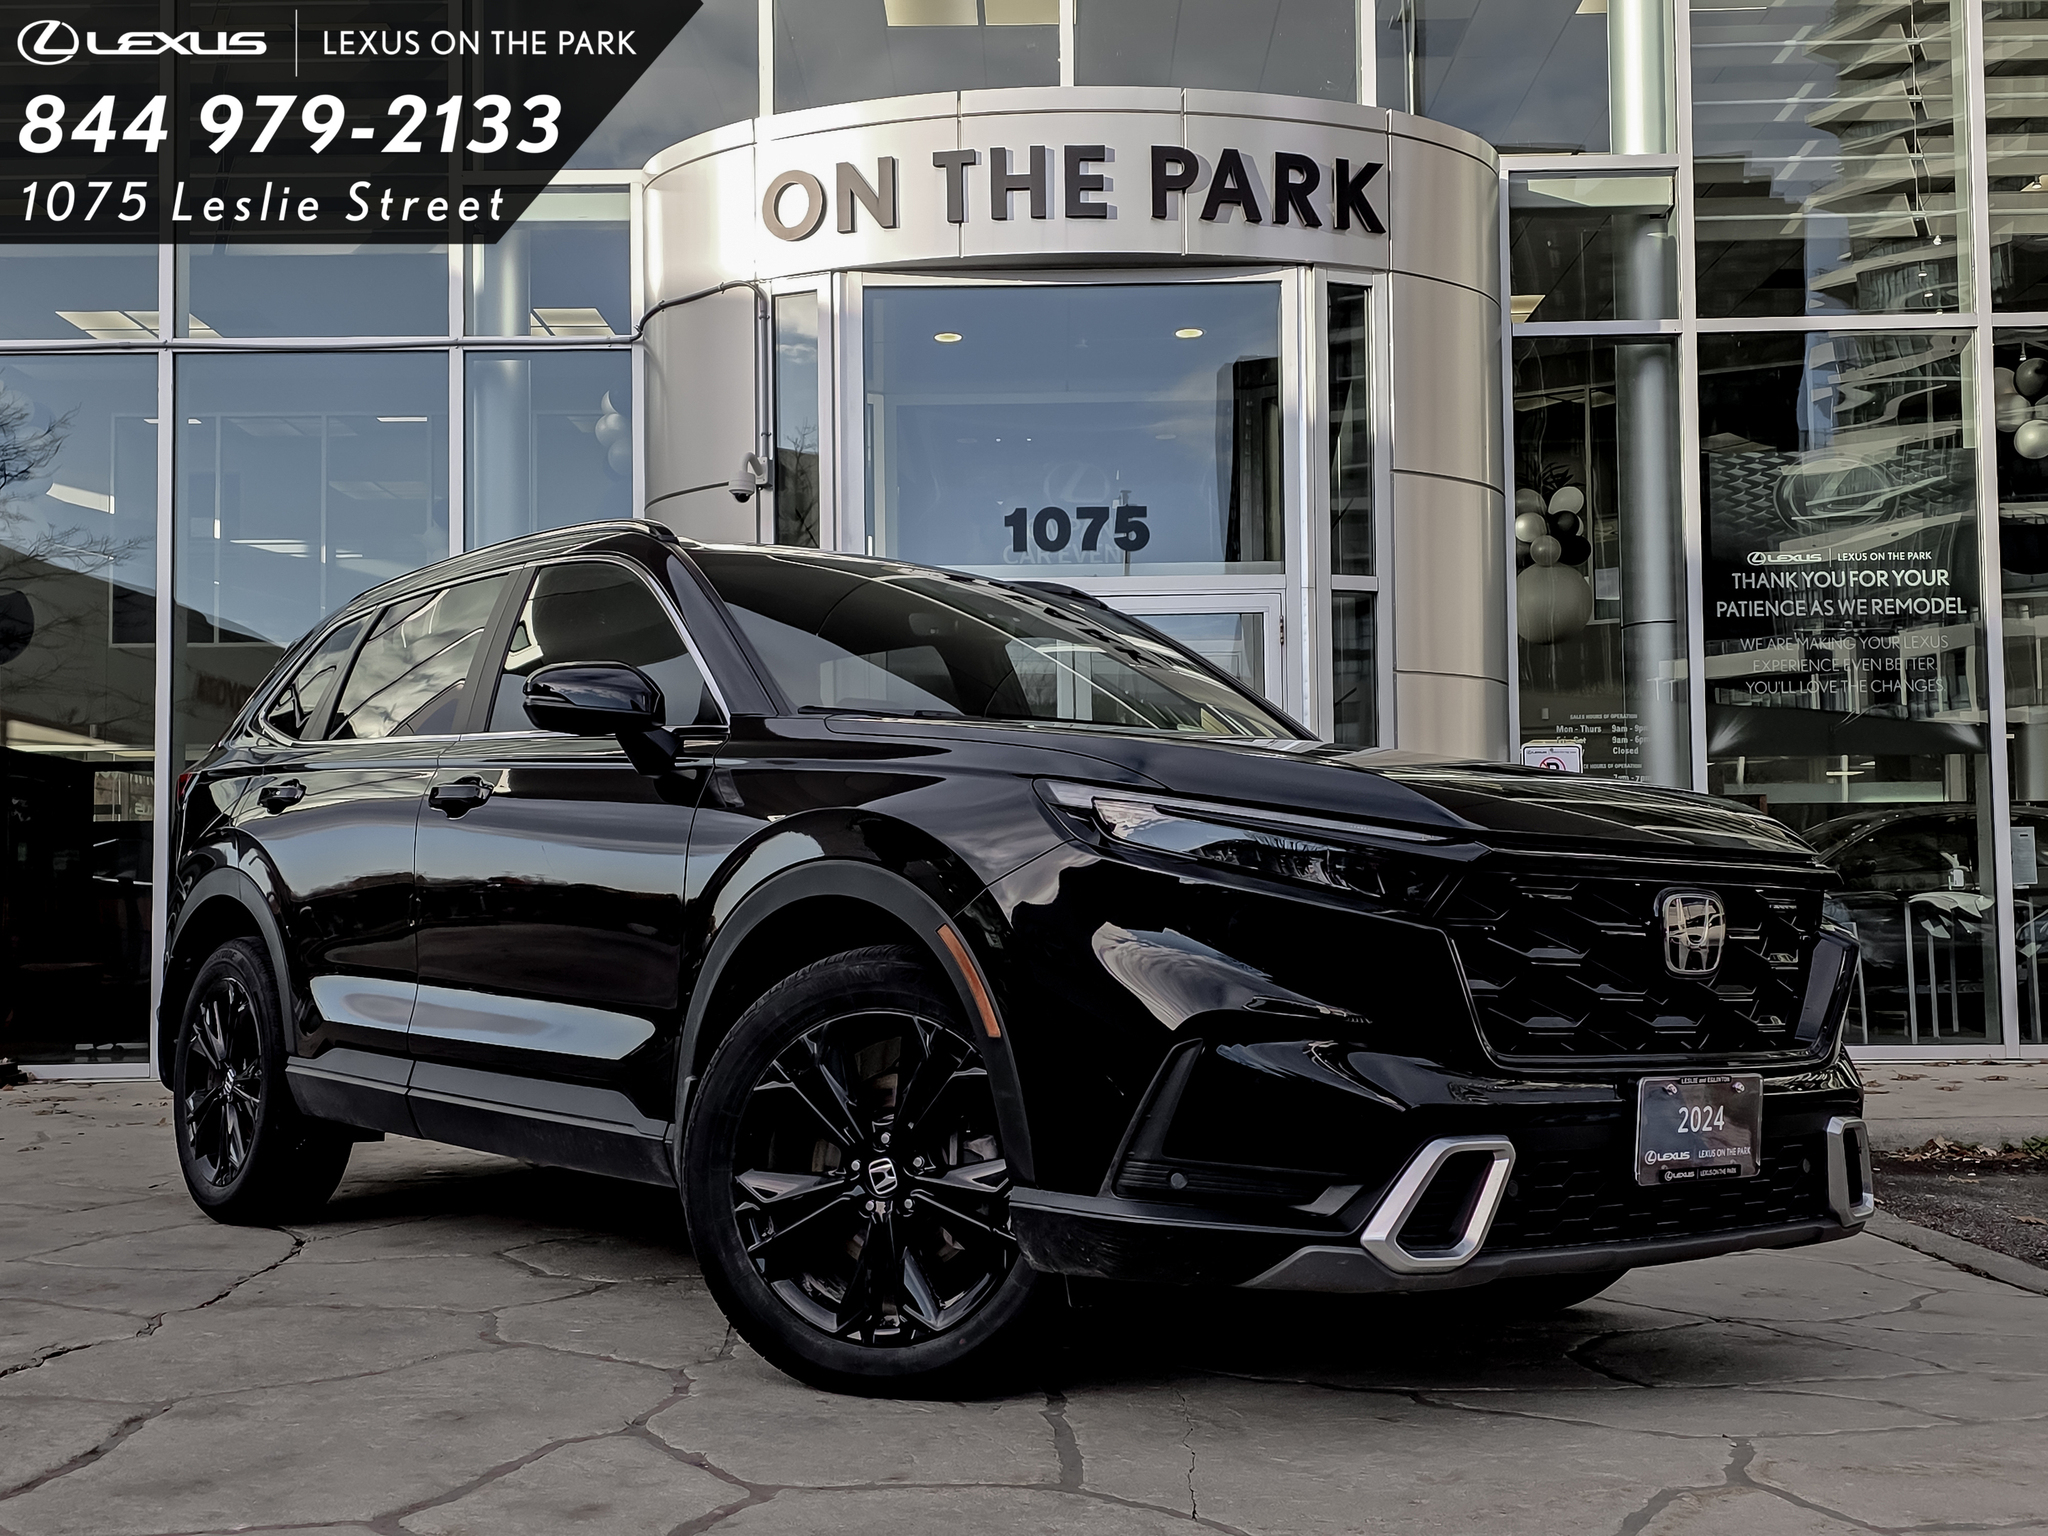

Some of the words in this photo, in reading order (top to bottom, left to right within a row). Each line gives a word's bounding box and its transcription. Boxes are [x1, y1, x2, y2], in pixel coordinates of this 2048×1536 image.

[762, 155, 899, 241] ON
[933, 144, 1116, 223] THE
[1150, 144, 1386, 234] PARK
[1004, 506, 1150, 552] 1075
[1768, 553, 1822, 562] LEXUS
[1837, 552, 1867, 562] LEXUS
[1869, 552, 1885, 561] ON
[1887, 551, 1905, 561] THE
[1907, 551, 1932, 560] PARK
[1731, 572, 1799, 589] THANK
[1800, 570, 1845, 588] YOU
[1850, 570, 1889, 587] FOR
[1891, 569, 1950, 586] YOUR
[1716, 600, 1807, 617] PATIENCE
[1810, 599, 1834, 616] AS
[1838, 599, 1867, 615] WE
[1872, 597, 1967, 615] REMODEL
[1740, 639, 1763, 650] WE
[1767, 638, 1793, 650] ARE
[1796, 636, 1856, 650] MAKING
[1858, 636, 1900, 649] YOUR
[1903, 635, 1949, 648] LEXUS
[1753, 659, 1839, 672] EXPERIENCE
[1844, 658, 1881, 671] EVEN
[1745, 680, 1796, 694] YOU'LL
[1800, 680, 1837, 694] LOVE
[1840, 680, 1867, 693] THE
[1556, 725, 1573, 733] Mon
[1580, 724, 1602, 733] Thurs
[1611, 724, 1628, 732] 9am
[1677, 1105, 1725, 1133] 2024
[1657, 1151, 1691, 1161] LEXUS
[1698, 1149, 1716, 1159] LEXUS
[1716, 1148, 1726, 1157] ON
[1726, 1147, 1736, 1156] THE
[1737, 1146, 1751, 1155] PARK
